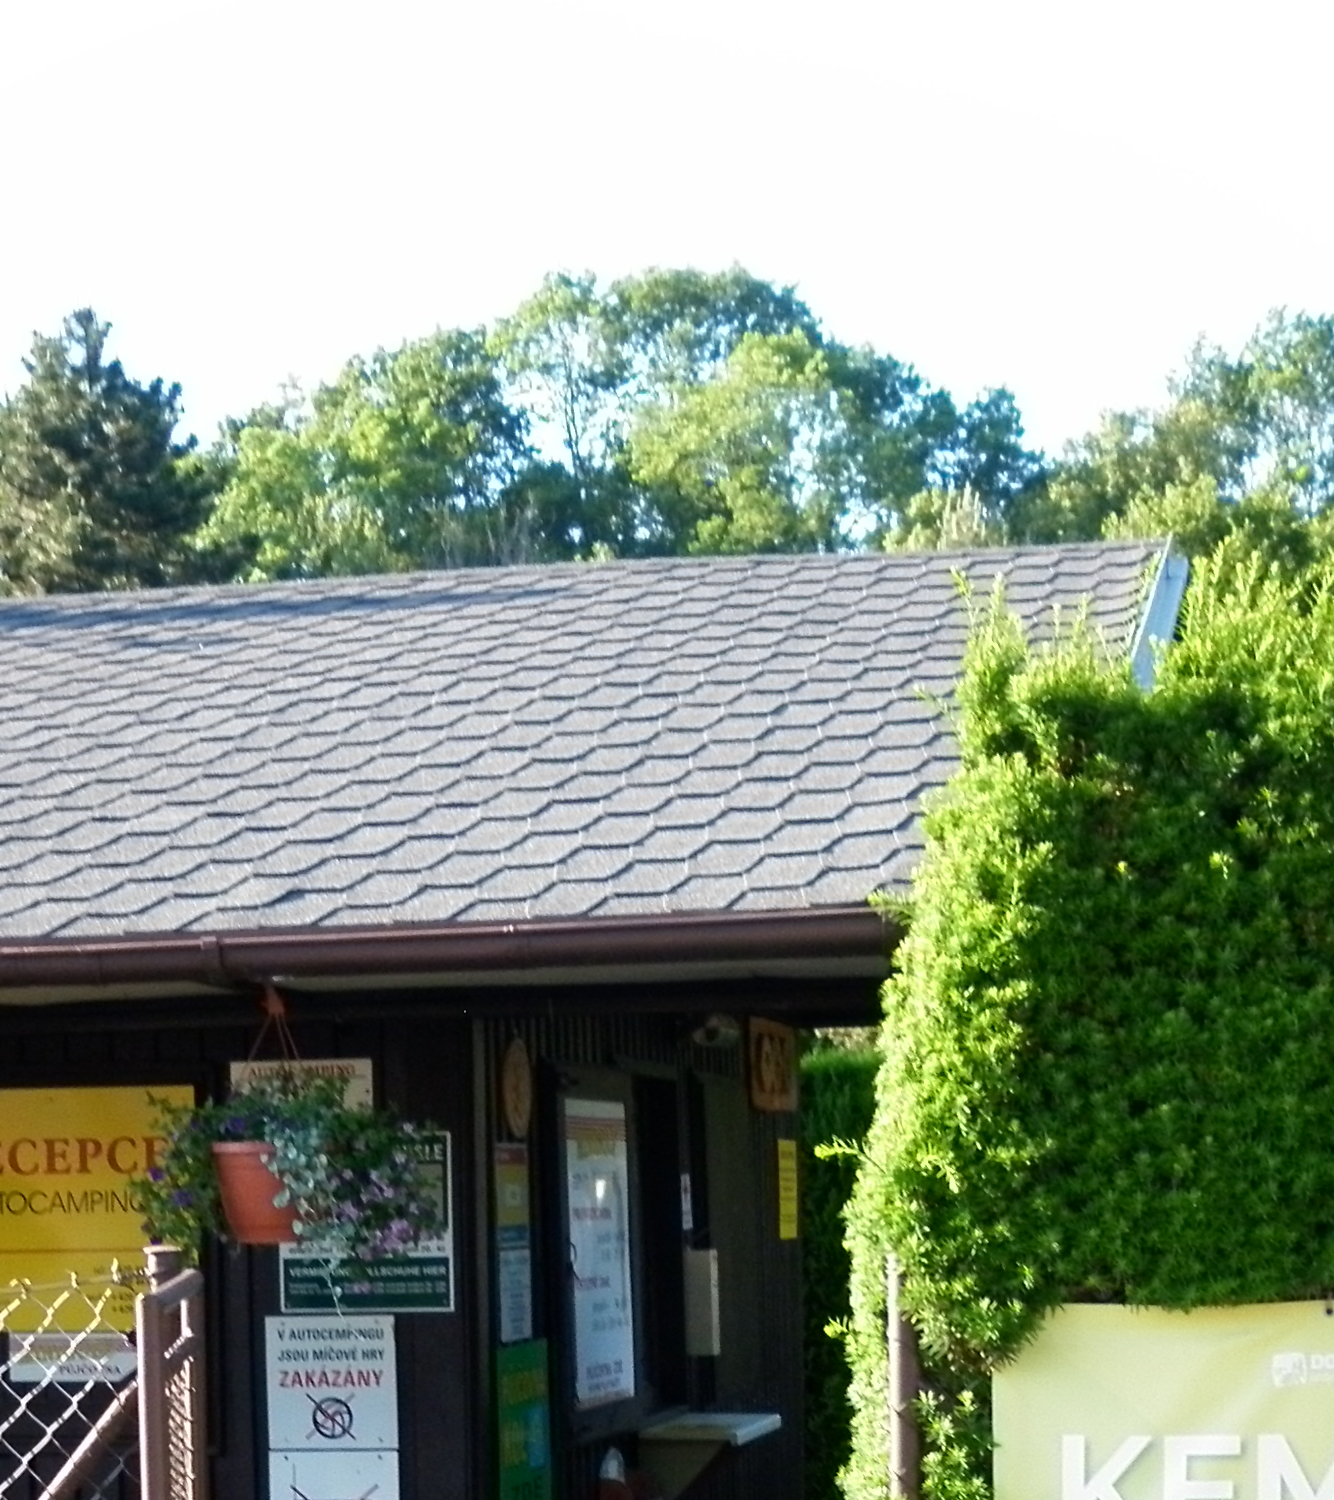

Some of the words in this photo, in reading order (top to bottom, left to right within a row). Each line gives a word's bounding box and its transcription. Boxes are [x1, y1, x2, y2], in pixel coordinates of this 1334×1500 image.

[277, 1328, 286, 1341] V
[277, 1349, 309, 1362] JSOU
[361, 1348, 385, 1361] HRY
[279, 1364, 384, 1389] ZAKÁZÁNY
